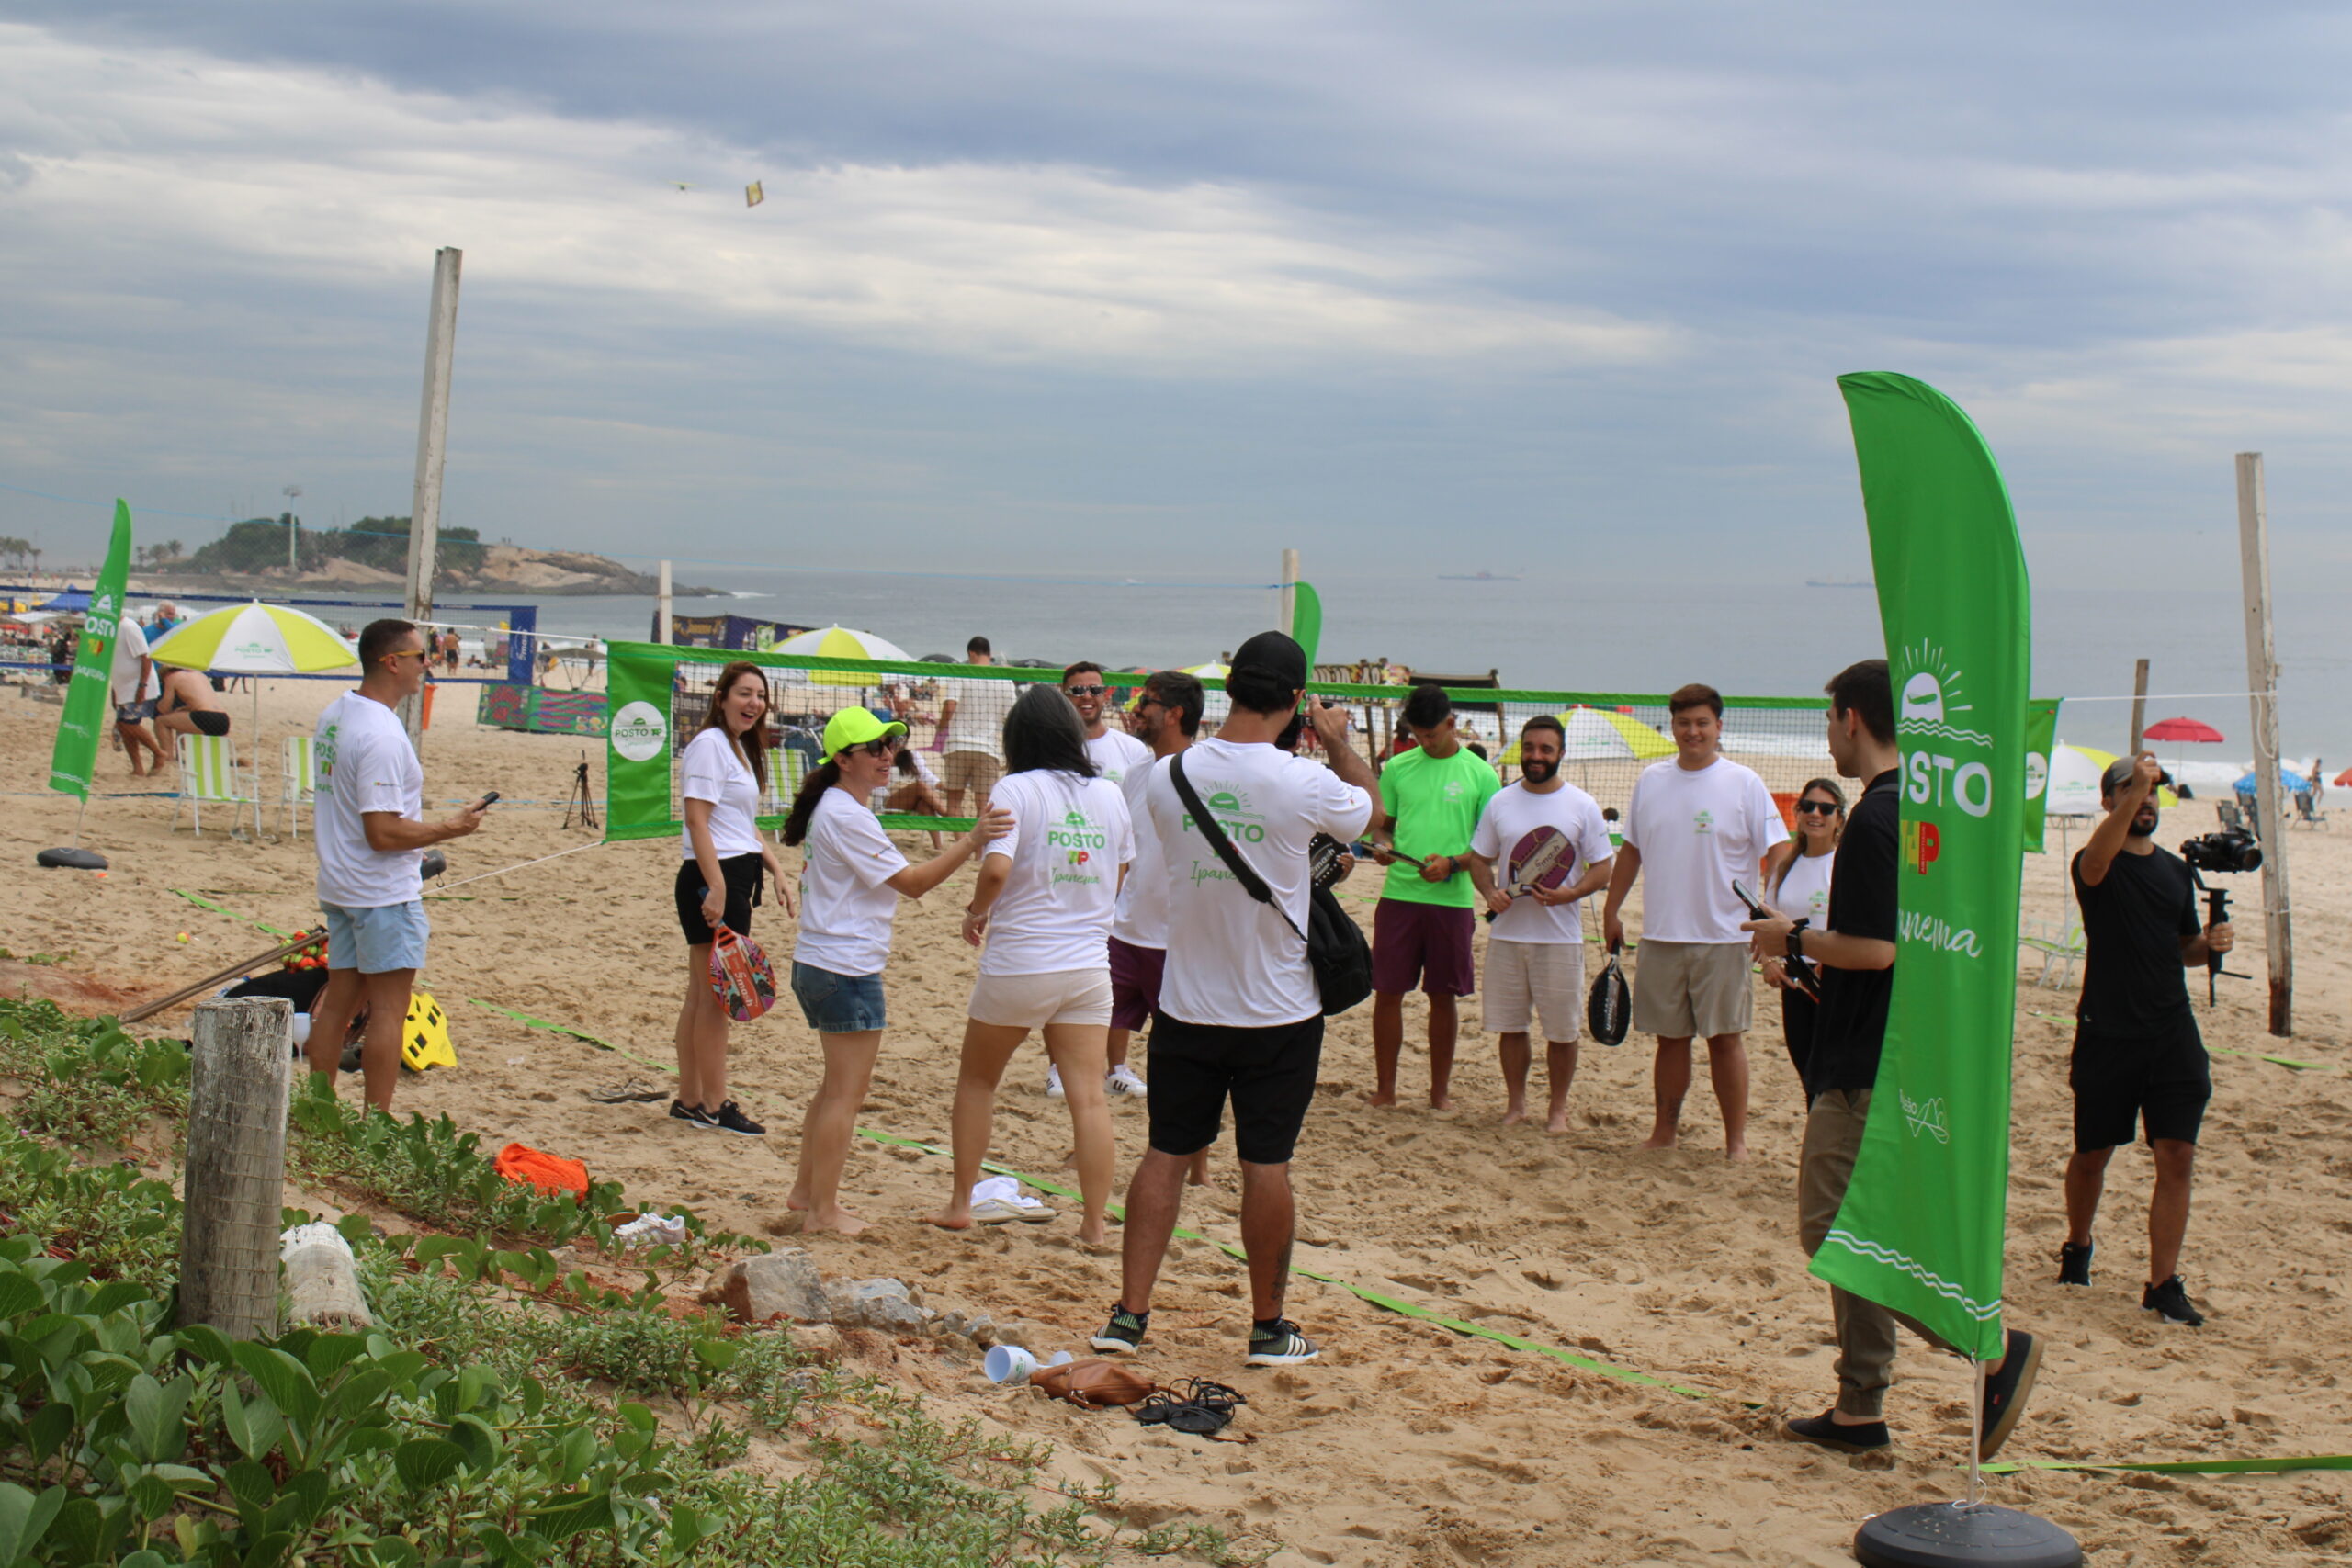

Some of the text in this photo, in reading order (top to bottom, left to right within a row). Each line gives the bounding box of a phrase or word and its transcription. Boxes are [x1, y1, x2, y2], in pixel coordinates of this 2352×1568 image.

[616, 728, 649, 738] POSTO
[1182, 814, 1265, 843] PSTO
[1048, 830, 1106, 850] POSTO
